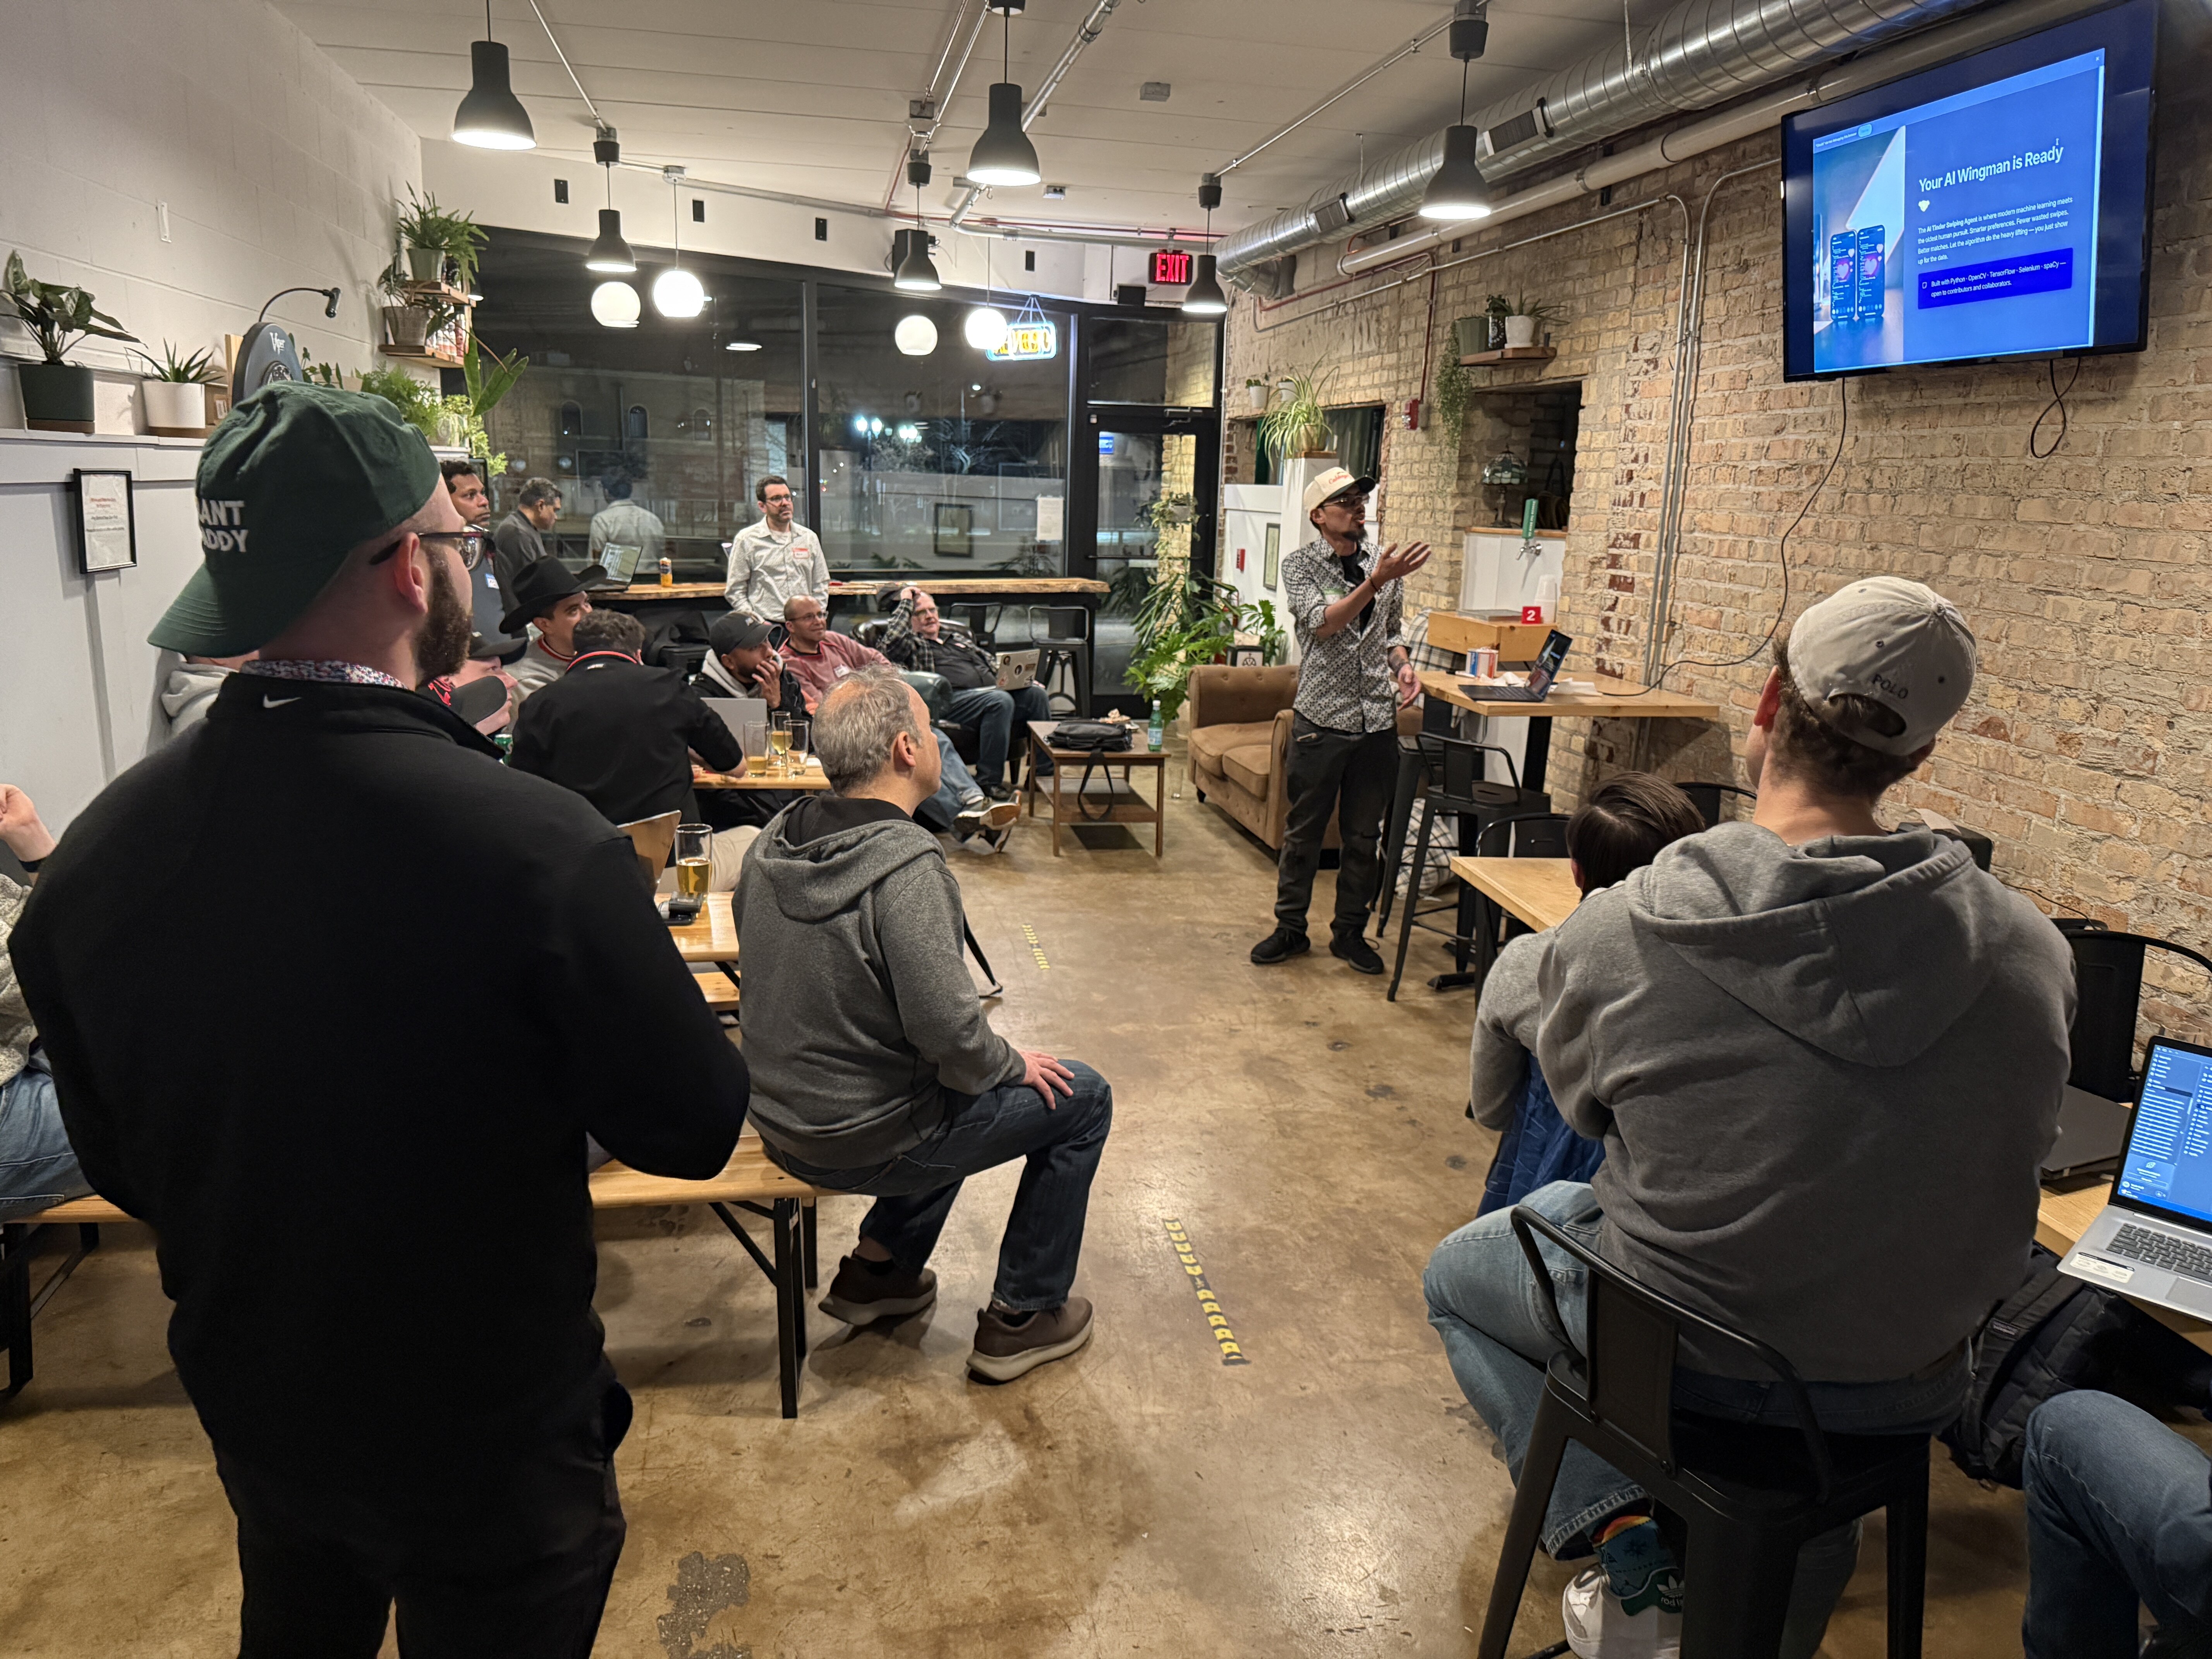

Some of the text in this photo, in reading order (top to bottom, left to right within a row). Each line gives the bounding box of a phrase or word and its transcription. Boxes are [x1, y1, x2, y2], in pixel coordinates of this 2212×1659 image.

[1919, 146, 2064, 192] Your AI Wingman is Ready
[1964, 216, 1978, 225] Agent
[2016, 205, 2036, 214] machine
[2037, 201, 2056, 210] learning
[2057, 197, 2073, 205] meets
[1953, 229, 1969, 238] pursuit.
[1970, 226, 1987, 234] Smarter
[1987, 220, 2016, 232] preferences.
[2032, 212, 2049, 222] wasted
[1965, 237, 1985, 246] algorithm
[2035, 225, 2044, 234] you
[2044, 223, 2054, 232] just
[1156, 254, 1189, 282] EXIT
[1968, 272, 1987, 282] OpenCV
[1989, 269, 2016, 277] TensorFlow
[2018, 264, 2040, 273] Selenium
[2043, 261, 2059, 270] spaCy
[1947, 286, 1972, 295] contributors
[1982, 280, 2012, 289] collaborators.
[1527, 610, 1535, 621] 2
[1872, 674, 1909, 699] POLO
